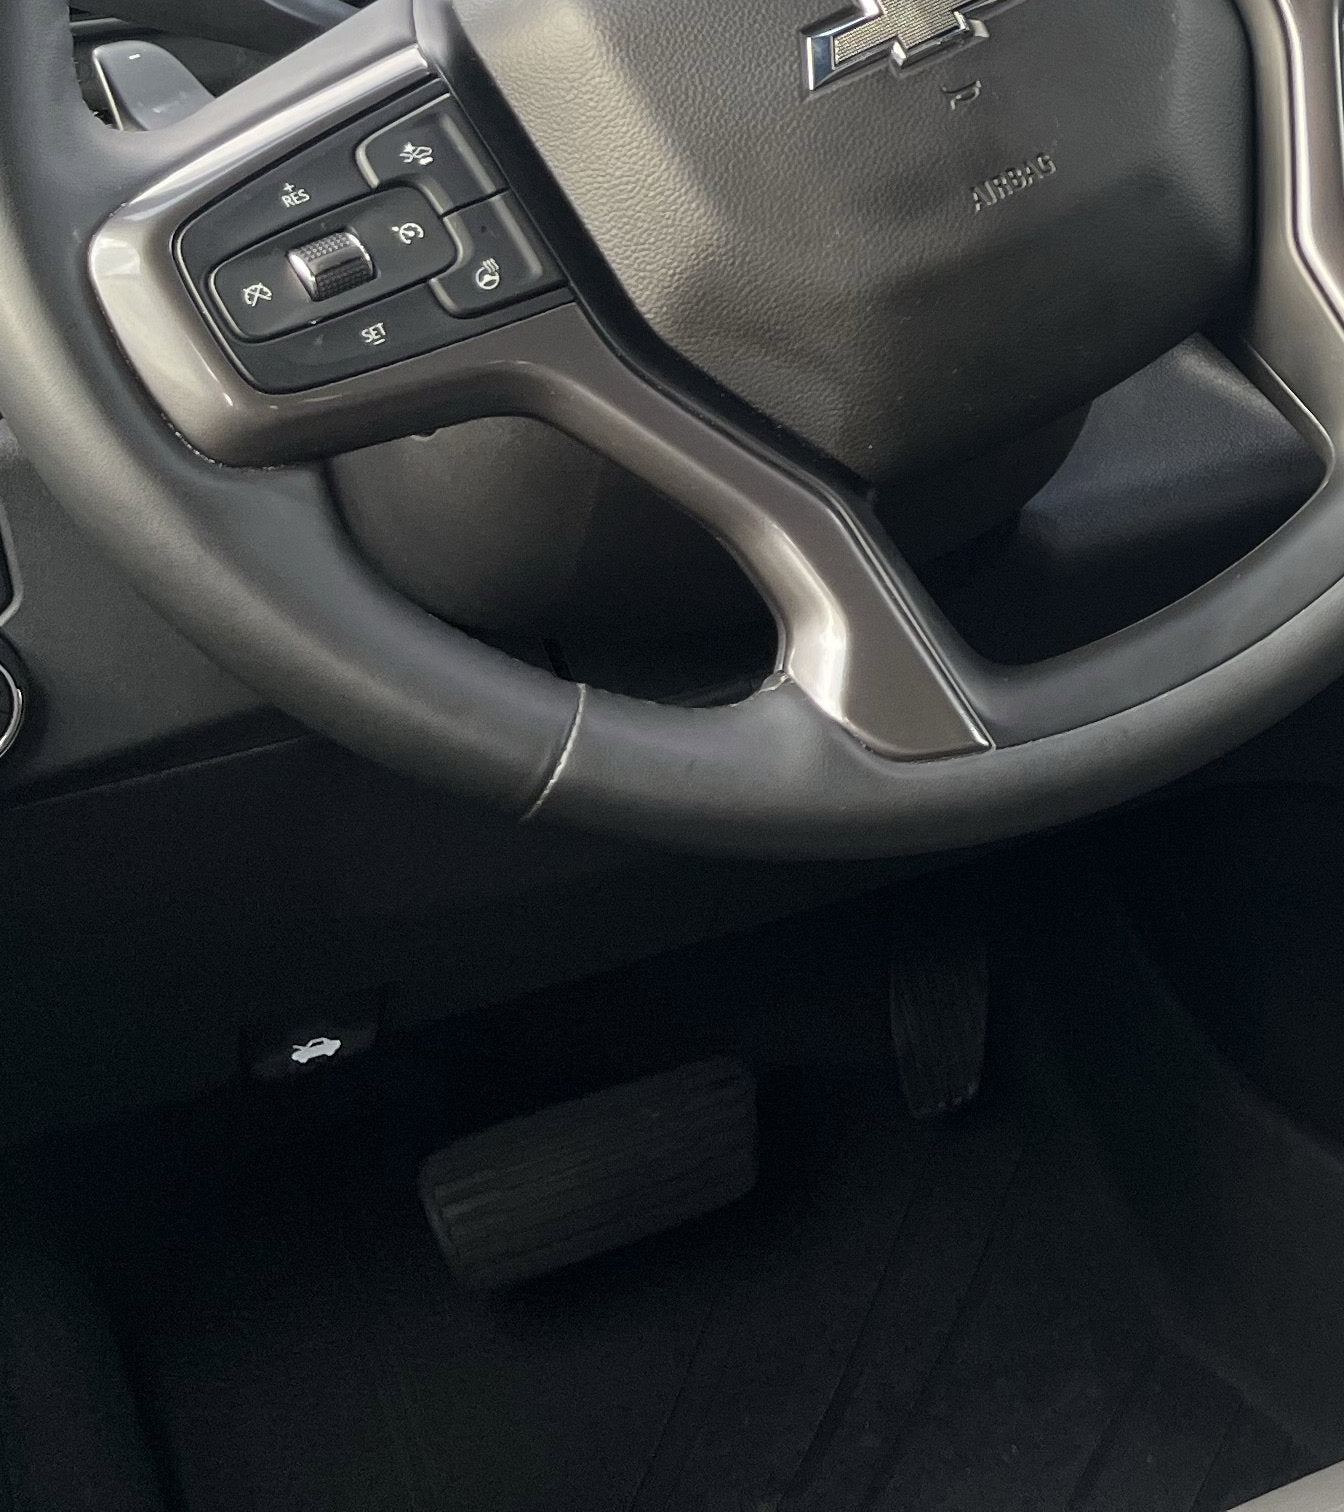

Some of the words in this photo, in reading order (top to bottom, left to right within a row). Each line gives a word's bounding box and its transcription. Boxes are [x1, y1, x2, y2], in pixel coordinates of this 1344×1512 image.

[971, 155, 1057, 212] AIRBAG
[281, 189, 310, 207] RES
[361, 322, 386, 340] SET
